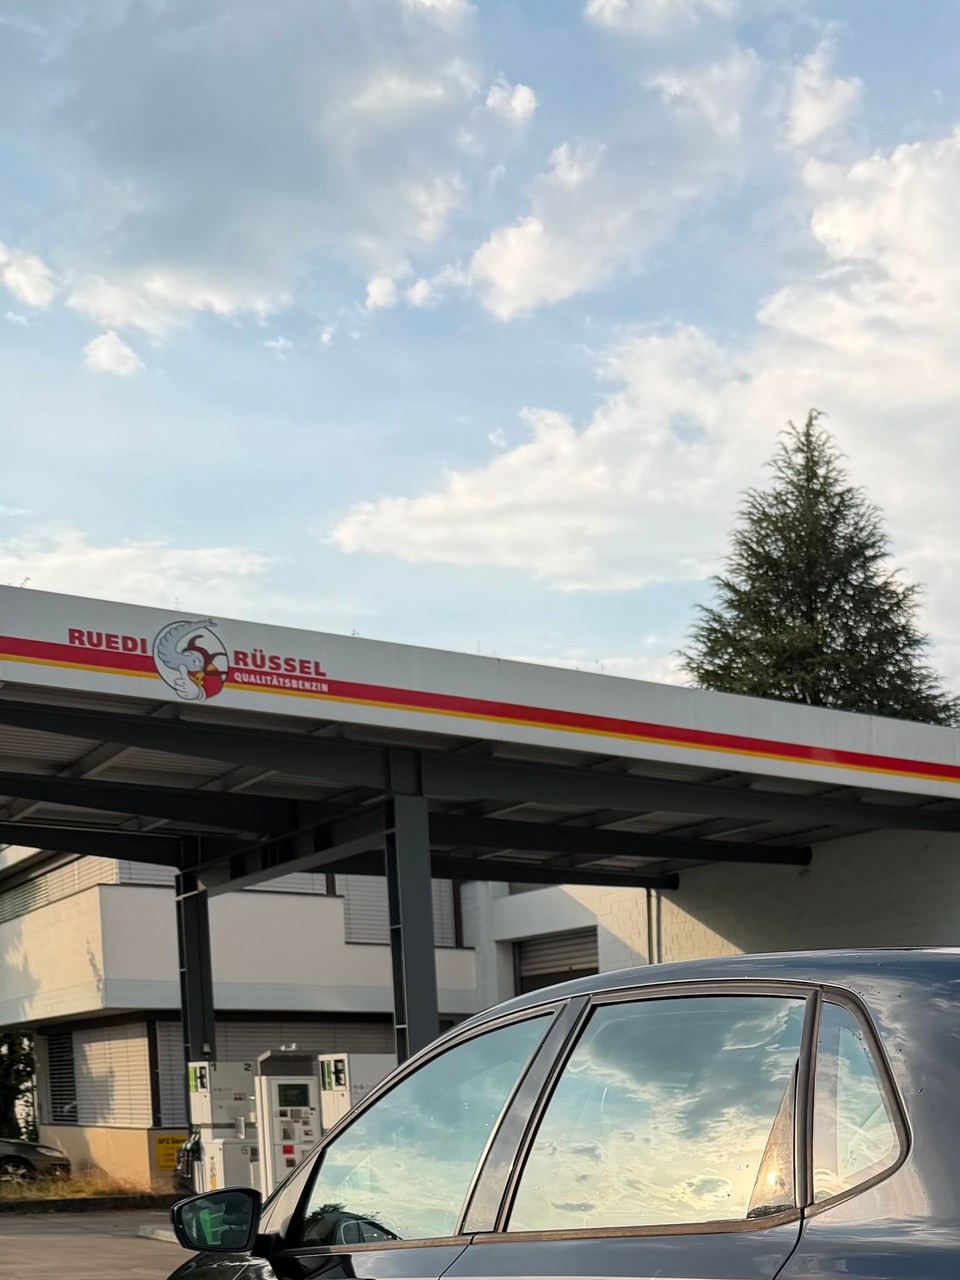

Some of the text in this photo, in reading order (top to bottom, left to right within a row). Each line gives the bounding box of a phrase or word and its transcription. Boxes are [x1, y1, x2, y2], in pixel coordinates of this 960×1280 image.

[68, 628, 148, 654] RUEDI
[233, 648, 327, 677] RÜSSEL
[233, 672, 329, 693] QUALITÄTSBENZIN
[244, 1063, 251, 1072] 2
